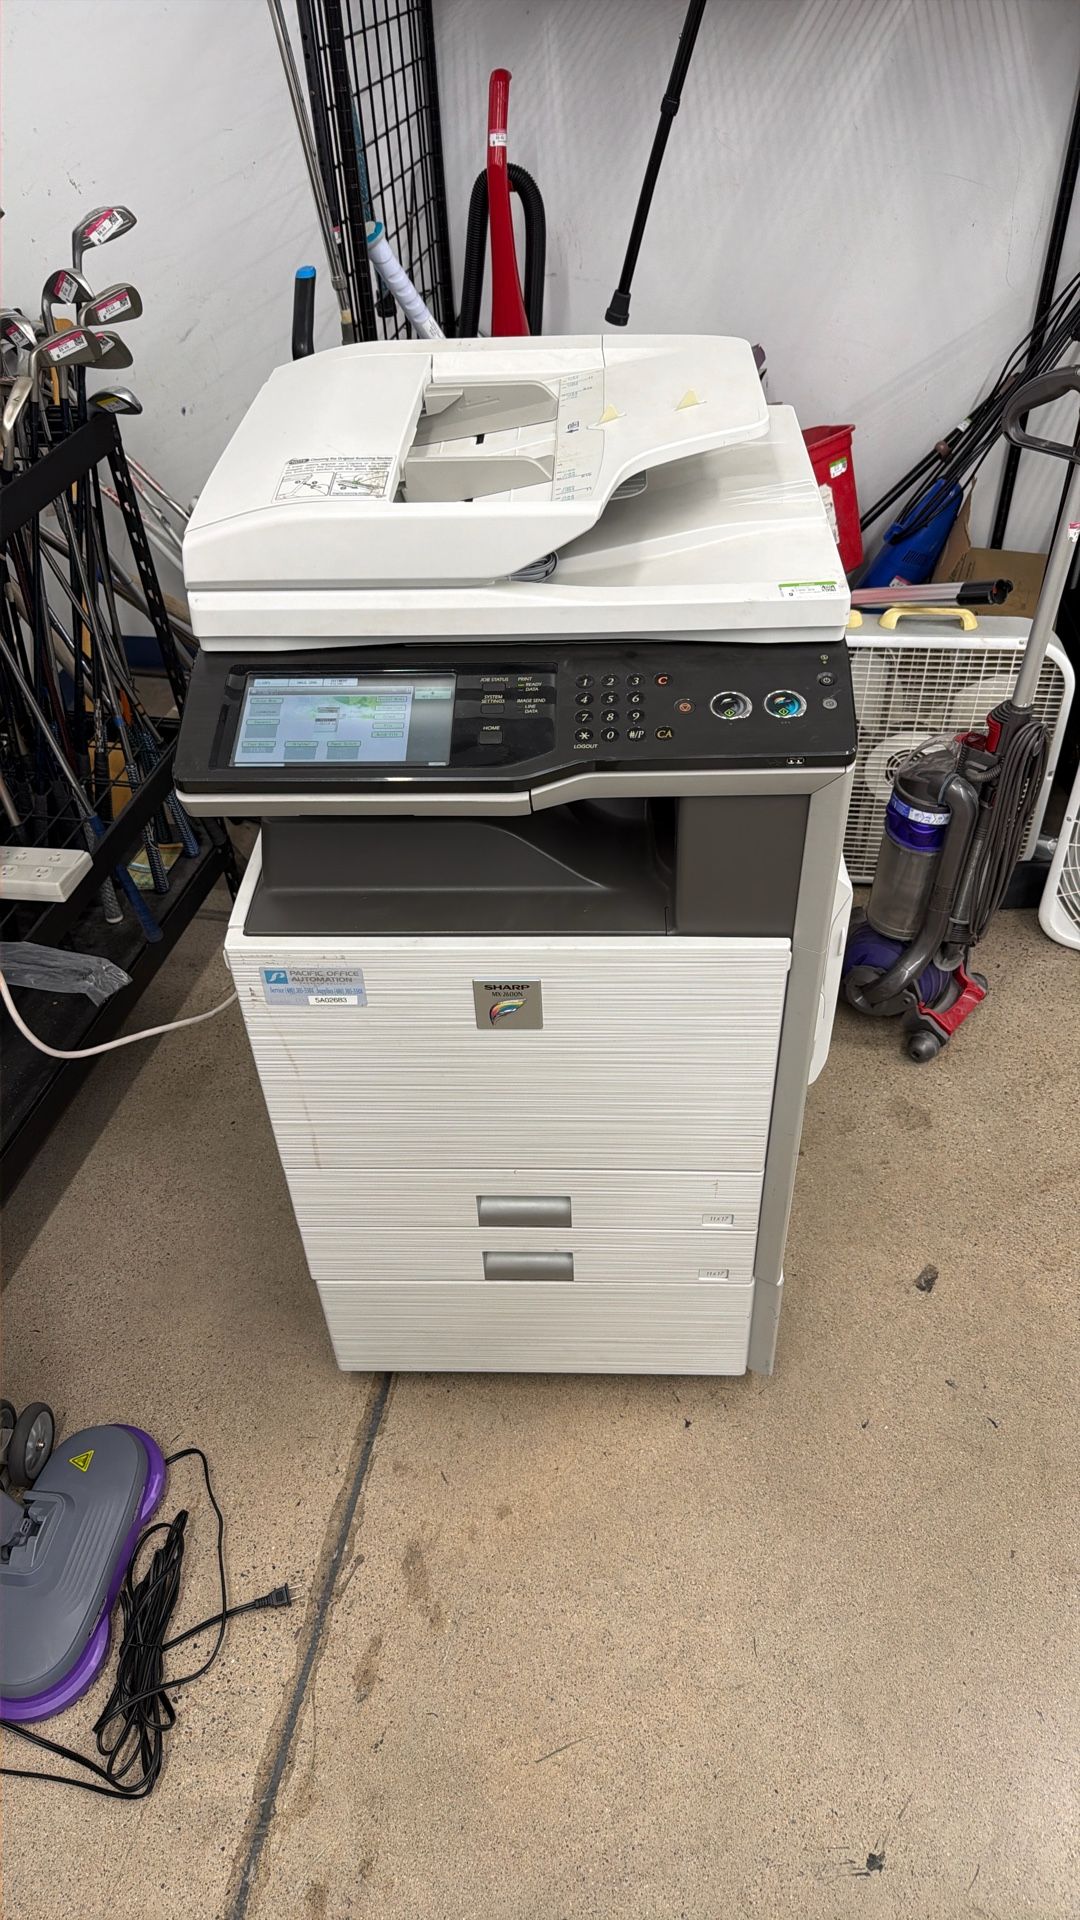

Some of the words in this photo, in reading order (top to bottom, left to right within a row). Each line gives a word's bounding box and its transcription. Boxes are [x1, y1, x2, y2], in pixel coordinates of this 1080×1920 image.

[583, 678, 588, 686] 1
[606, 678, 615, 686] 2
[631, 677, 640, 685] 3
[657, 676, 668, 685] C
[580, 696, 588, 704] 4
[606, 695, 614, 704] 5
[631, 694, 640, 703] 6
[581, 713, 589, 722] 7
[606, 713, 614, 721] 8
[632, 712, 640, 720] 9
[606, 731, 615, 739] 0
[629, 730, 644, 739] #/P
[656, 730, 673, 739] CA
